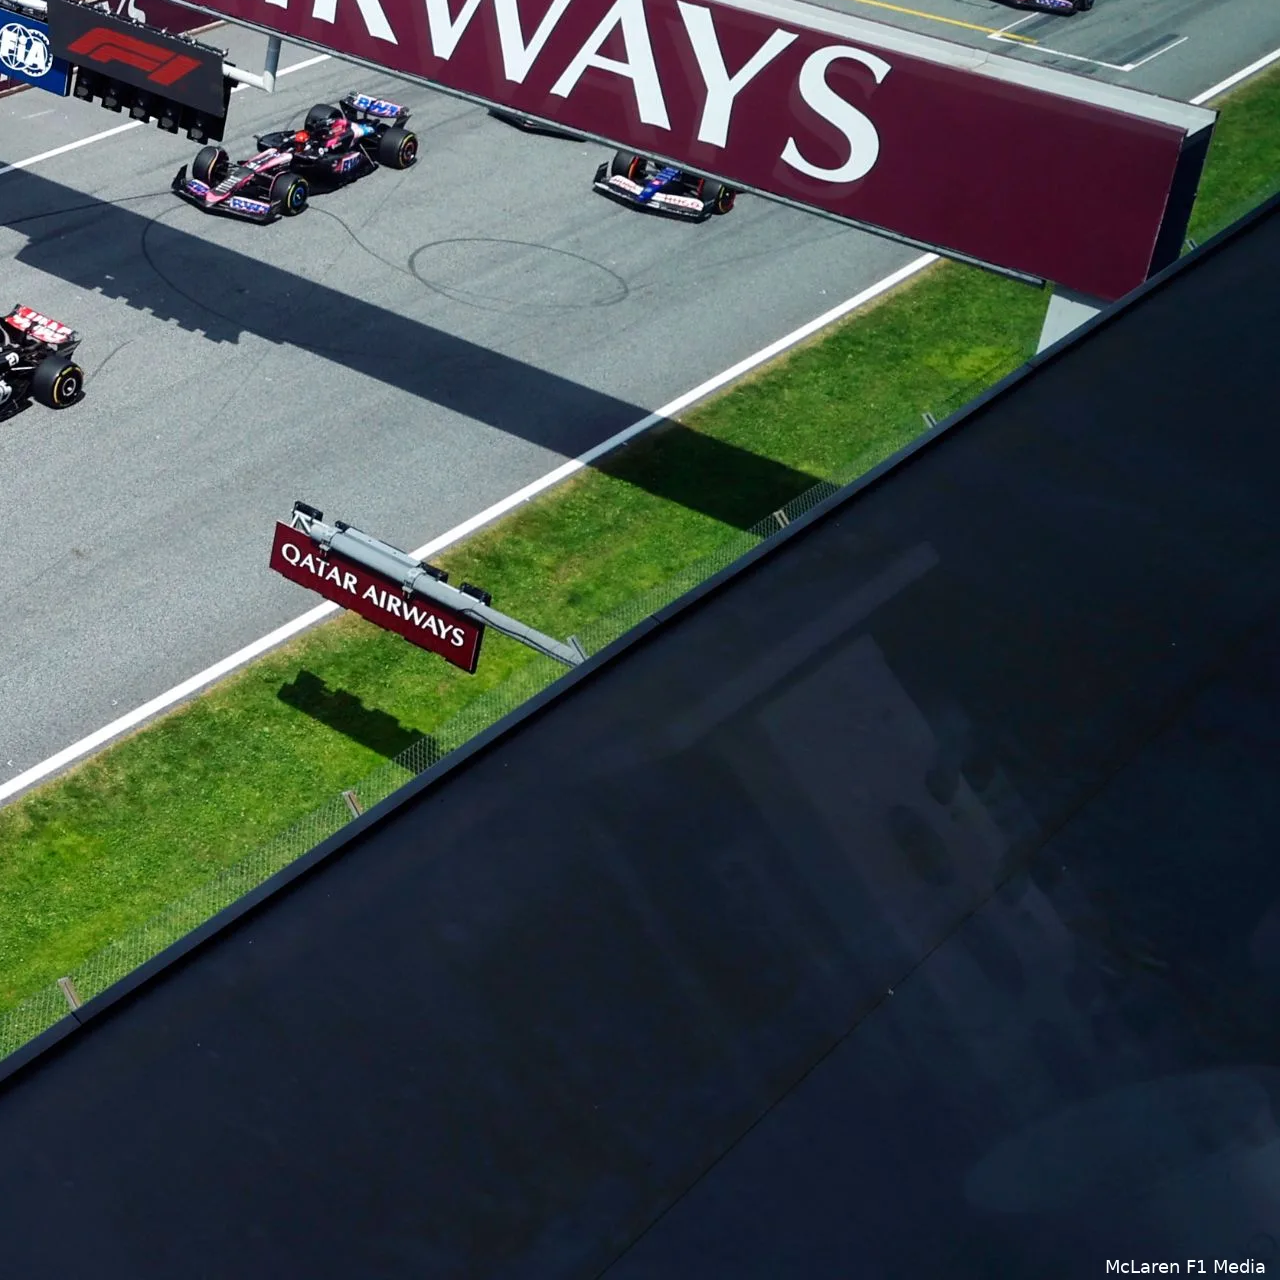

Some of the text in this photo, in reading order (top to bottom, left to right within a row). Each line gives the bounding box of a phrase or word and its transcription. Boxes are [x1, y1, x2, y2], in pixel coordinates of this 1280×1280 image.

[357, 94, 401, 116] BWT
[230, 197, 271, 215] BWT
[281, 543, 465, 648] QATAR AIRWAYS
